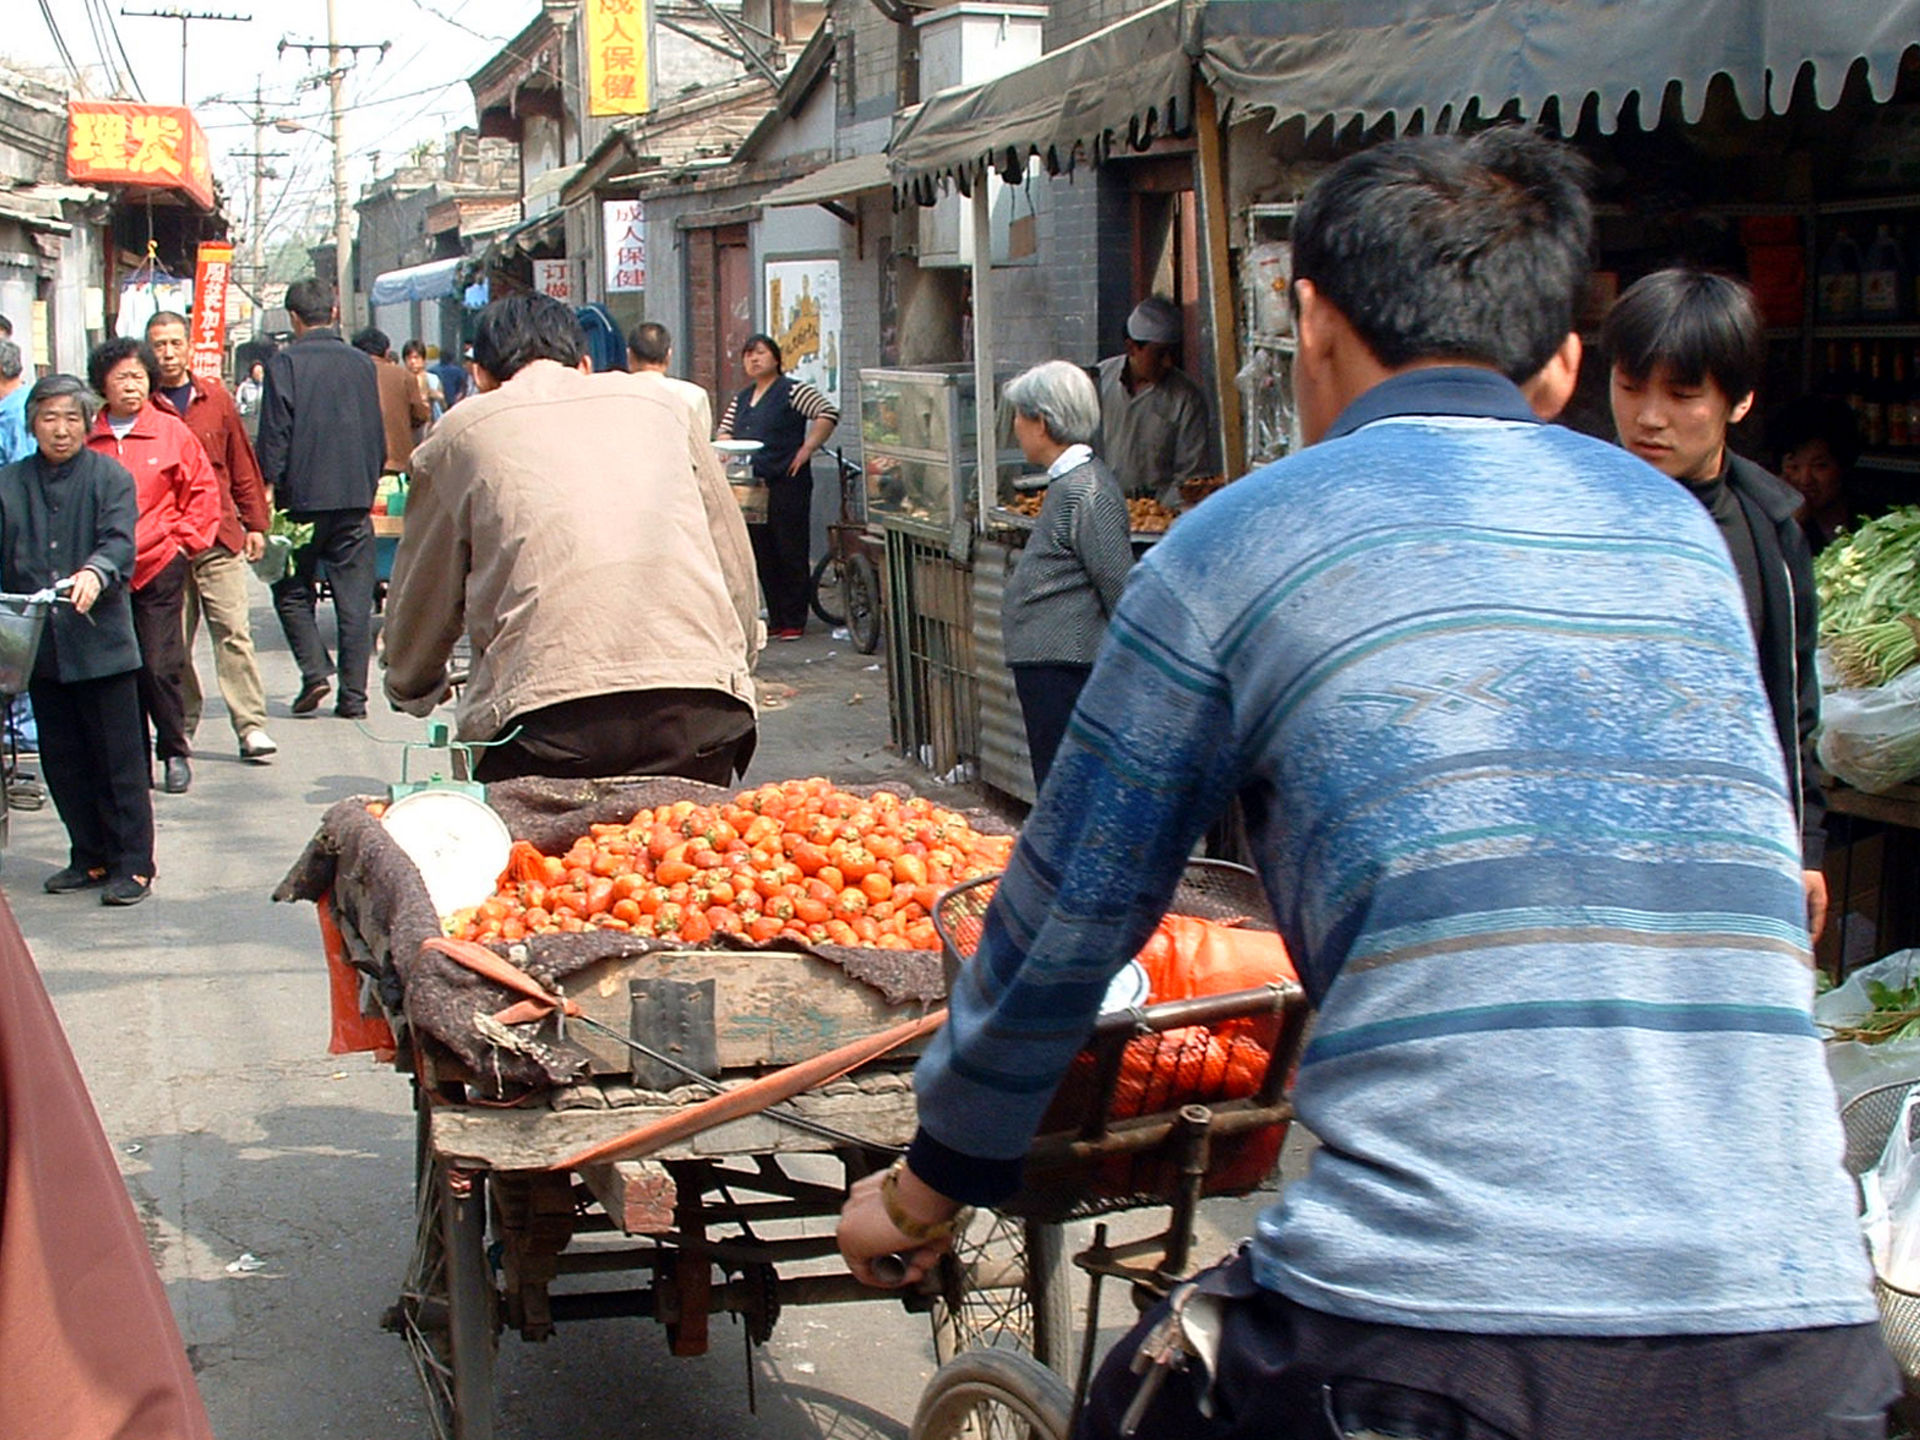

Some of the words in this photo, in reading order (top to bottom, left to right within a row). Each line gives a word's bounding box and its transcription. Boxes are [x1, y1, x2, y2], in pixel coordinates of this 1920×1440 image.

[72, 113, 183, 174] 理发
[616, 203, 646, 288] 成人保健
